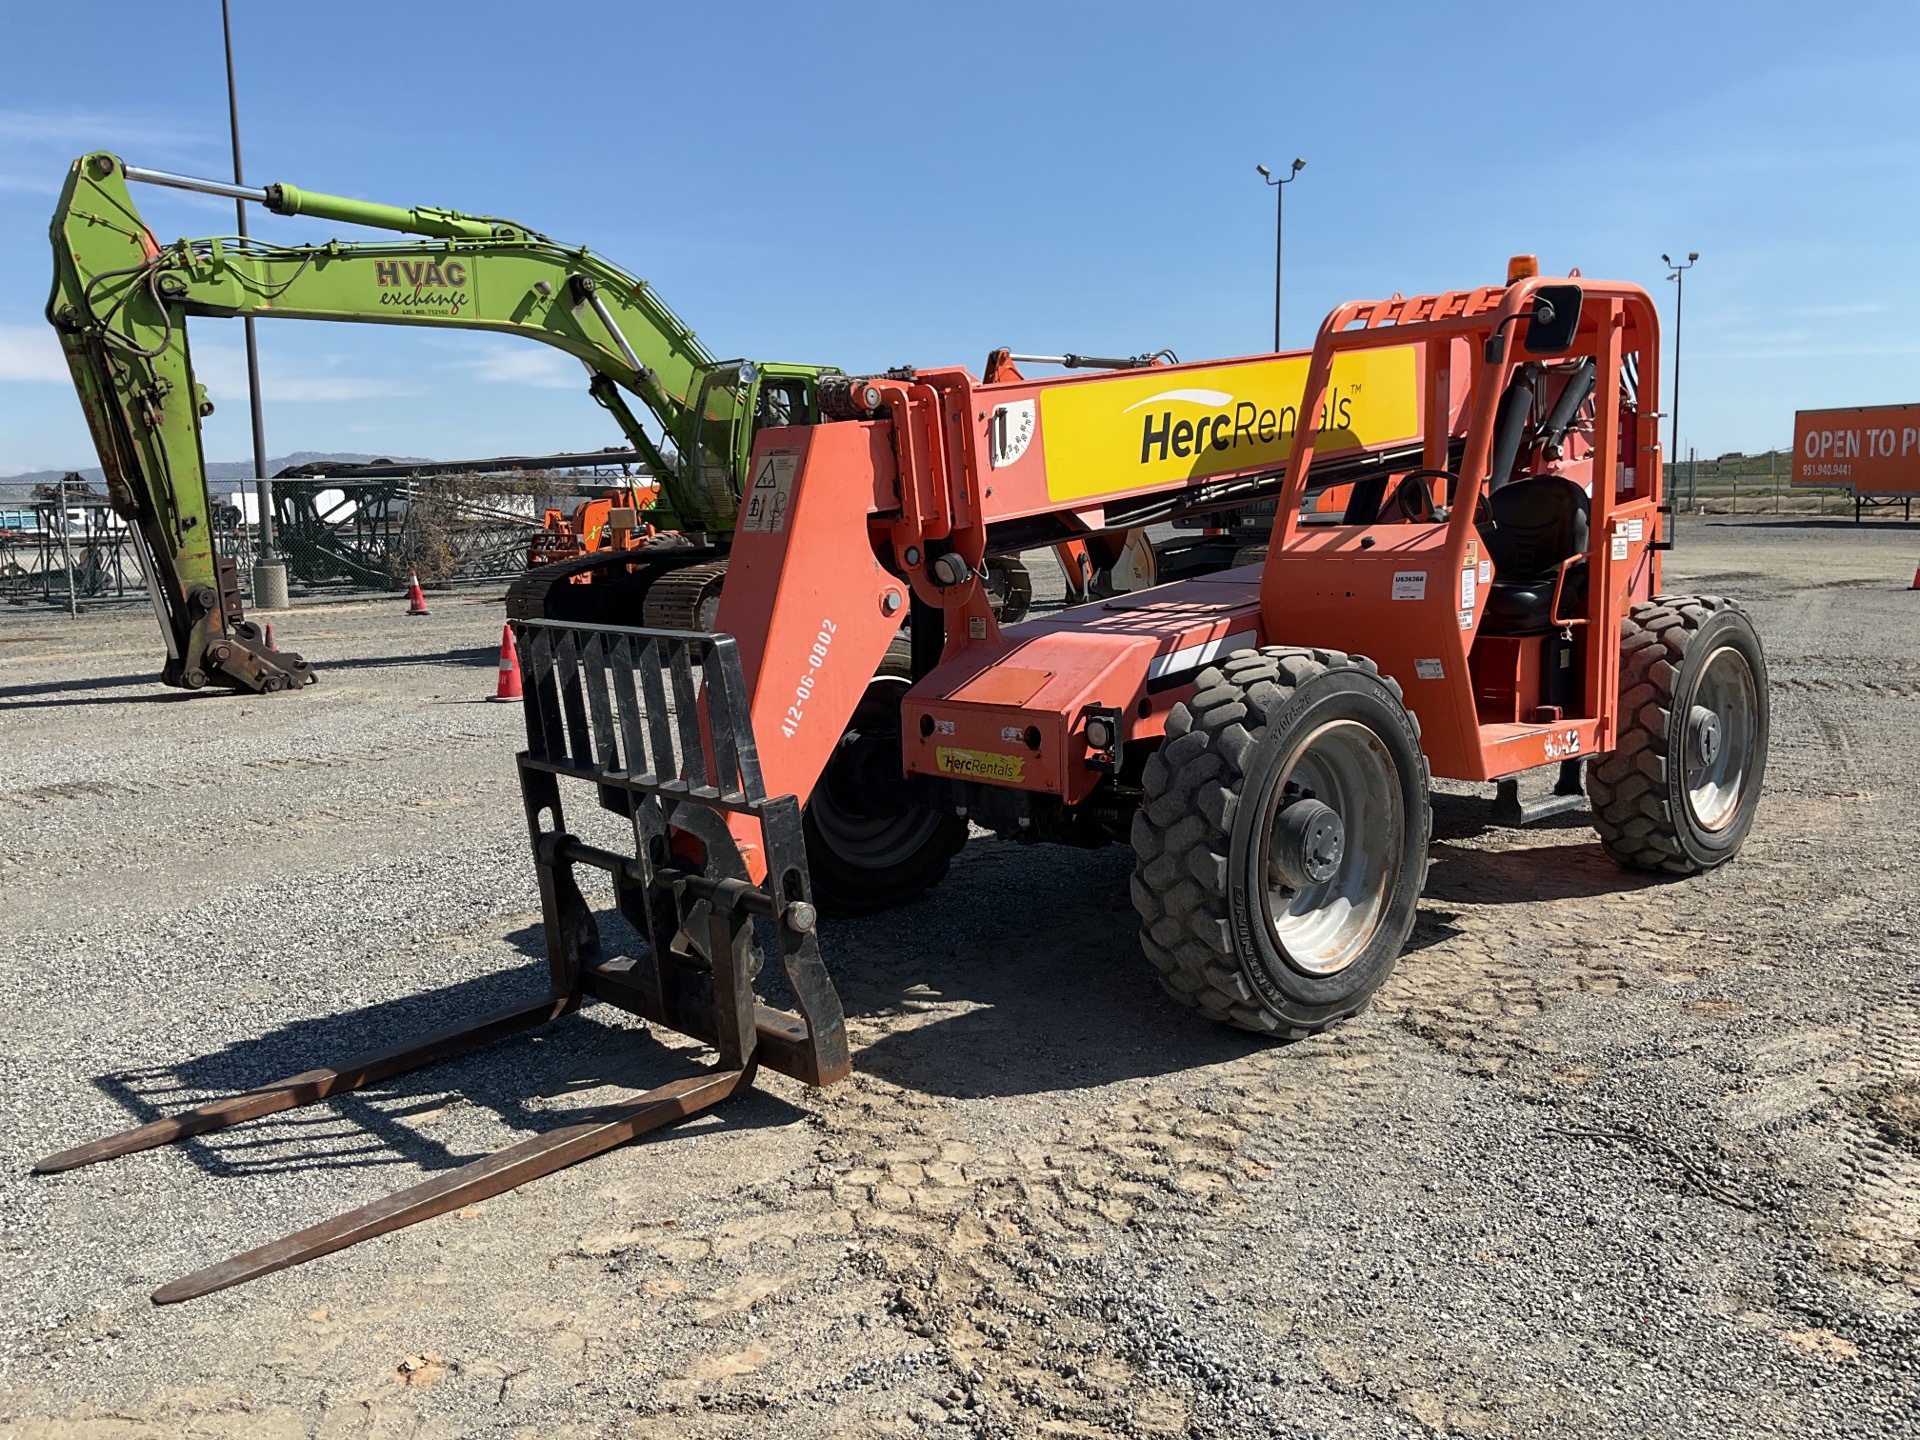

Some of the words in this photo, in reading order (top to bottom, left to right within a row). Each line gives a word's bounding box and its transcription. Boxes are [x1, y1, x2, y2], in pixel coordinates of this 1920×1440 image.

[375, 260, 468, 288] HVAC
[379, 282, 469, 315] exchange
[1804, 429, 1861, 458] OPEN
[1866, 427, 1897, 457] TO
[1901, 427, 1920, 457] P
[1803, 464, 1852, 476] 951.940.9441
[781, 618, 837, 739] 412-06-0802
[945, 755, 1014, 777] HercRentals
[1234, 885, 1289, 1009] LIGHTNING
